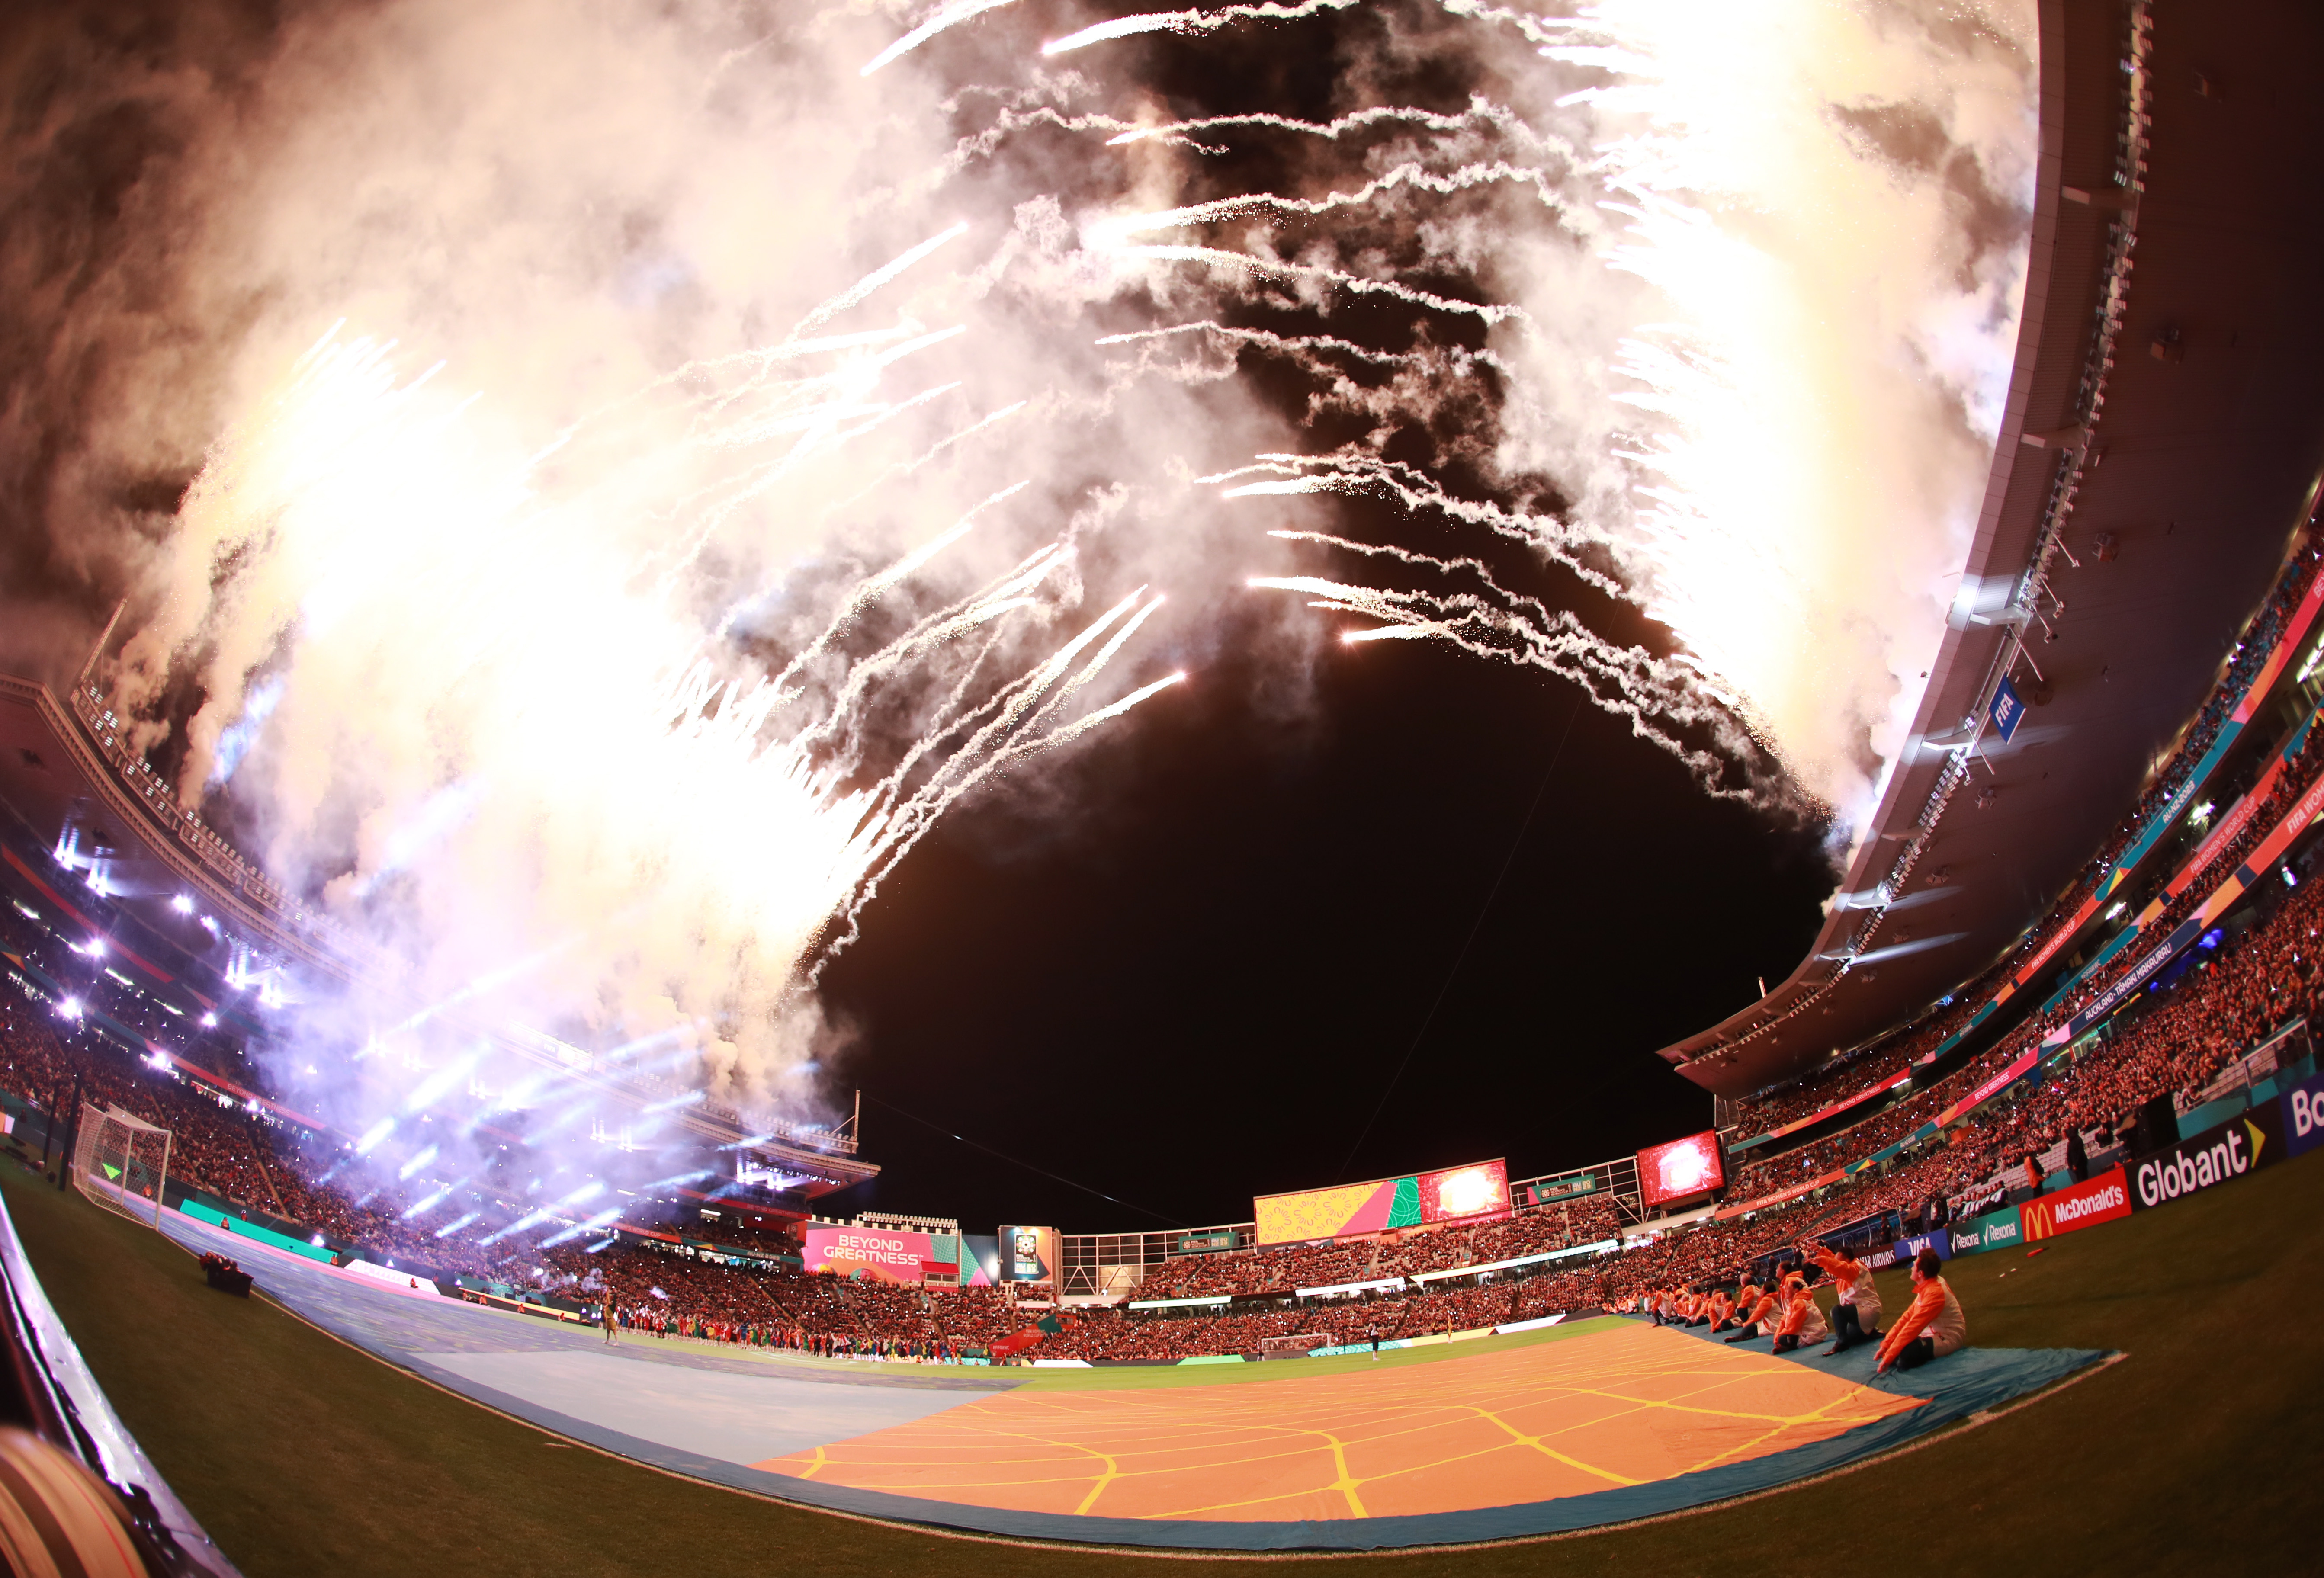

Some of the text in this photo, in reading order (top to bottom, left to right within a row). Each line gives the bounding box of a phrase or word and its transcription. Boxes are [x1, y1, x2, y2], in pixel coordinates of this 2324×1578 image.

[1995, 693, 2014, 727] FIFA
[2190, 796, 2255, 873] FIFA WOMEN'S WORLD CUP
[2287, 808, 2306, 834] FIFA
[2031, 920, 2075, 969] FIFA WOMEN'S WORLD CUP
[2136, 942, 2172, 979] MAKAURAU
[543, 1043, 556, 1053] FIFA
[228, 1084, 253, 1099] BEYOND
[1838, 1086, 1881, 1110] BEYOND GREATNESS
[1974, 1072, 2009, 1100] BEYOND GREATNESS
[2138, 1129, 2247, 1206] Globant
[1767, 1190, 1791, 1203] WOMEN'S
[1792, 1184, 1809, 1194] WORLD
[2055, 1185, 2124, 1224] McDonald's
[838, 1234, 904, 1251] BEYOND
[1956, 1222, 2016, 1249] Rexona Rexona
[1857, 1249, 1895, 1268] TAR AIRWAYS
